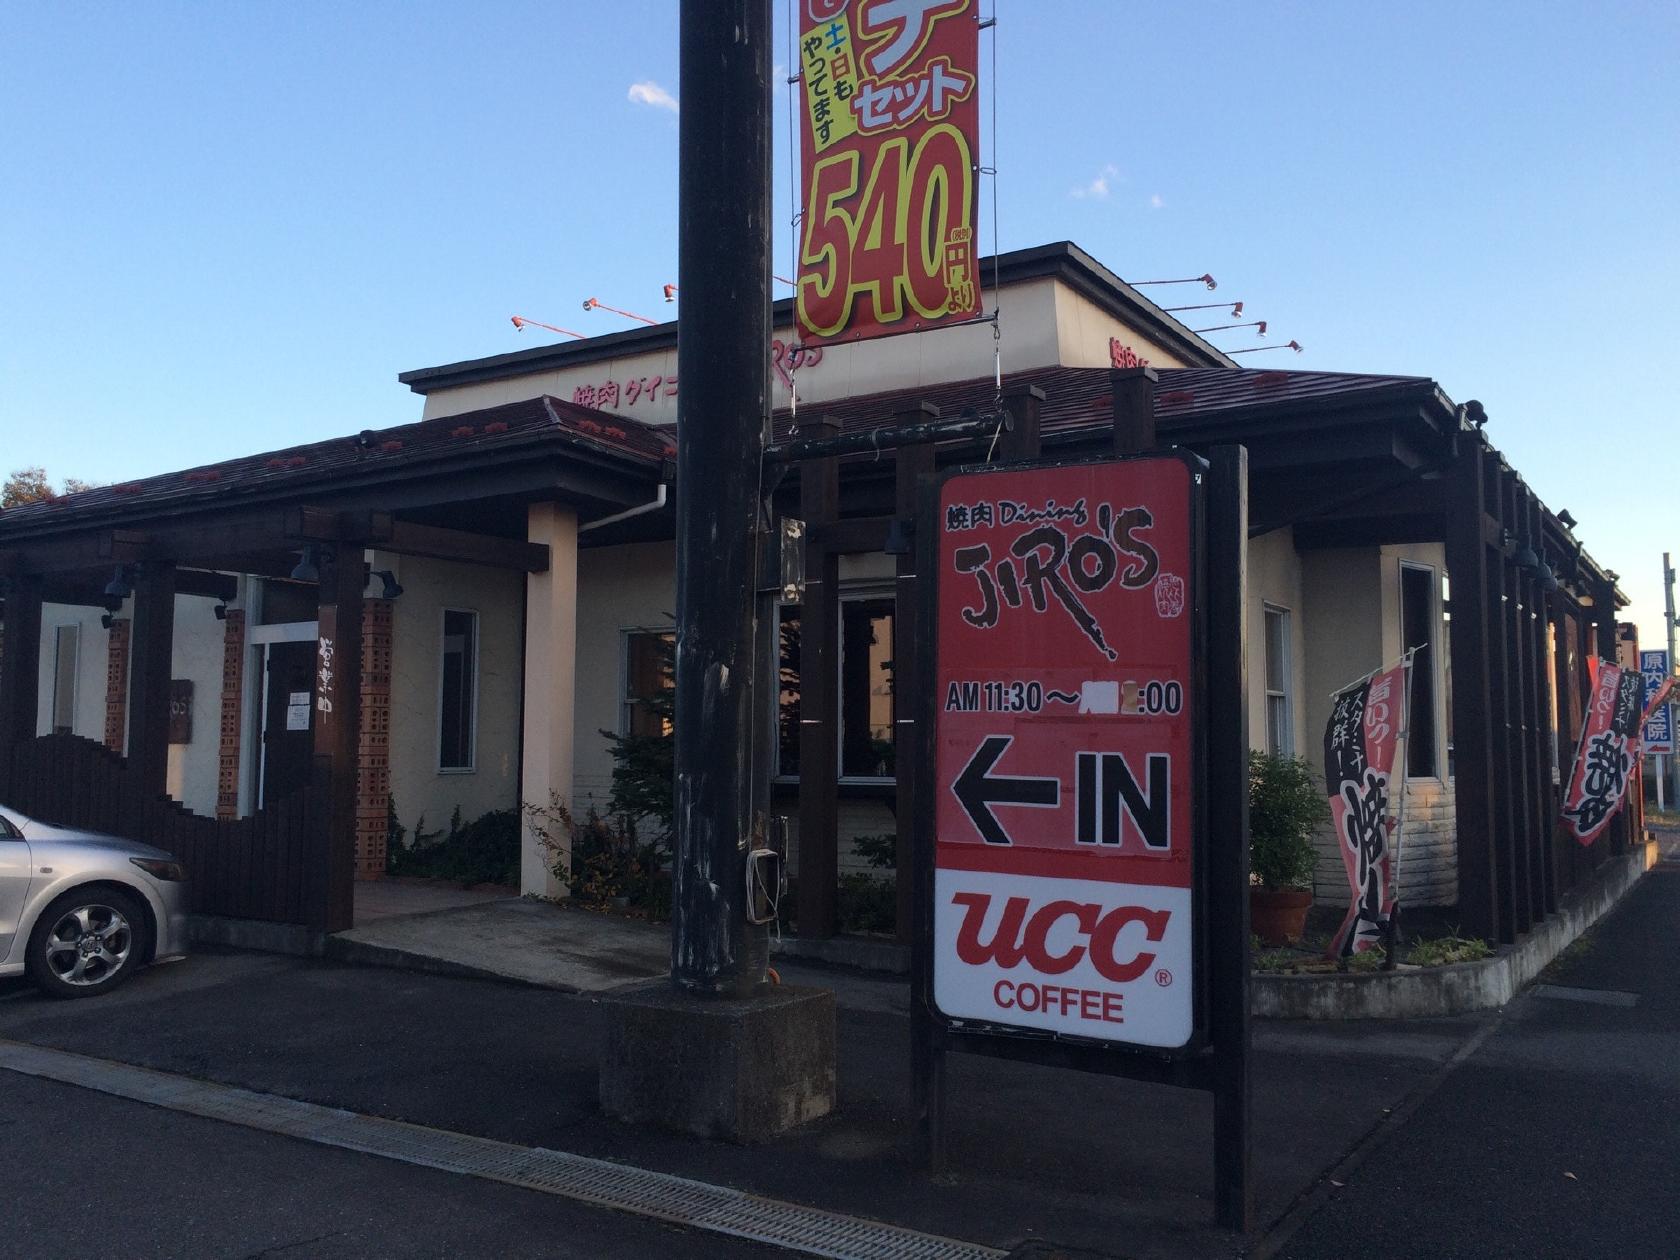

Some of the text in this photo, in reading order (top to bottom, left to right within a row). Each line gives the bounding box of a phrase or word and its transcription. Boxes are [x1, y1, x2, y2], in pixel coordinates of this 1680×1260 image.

[803, 36, 834, 144] やってます
[825, 23, 853, 101] 土・日も
[853, 63, 968, 128] セット
[797, 124, 972, 337] 540
[945, 498, 1088, 531] 焼肉 Dining
[945, 680, 979, 711] AM
[1075, 752, 1171, 850] IN
[951, 892, 1172, 983] UCC
[993, 980, 1124, 1024] COFFEE
